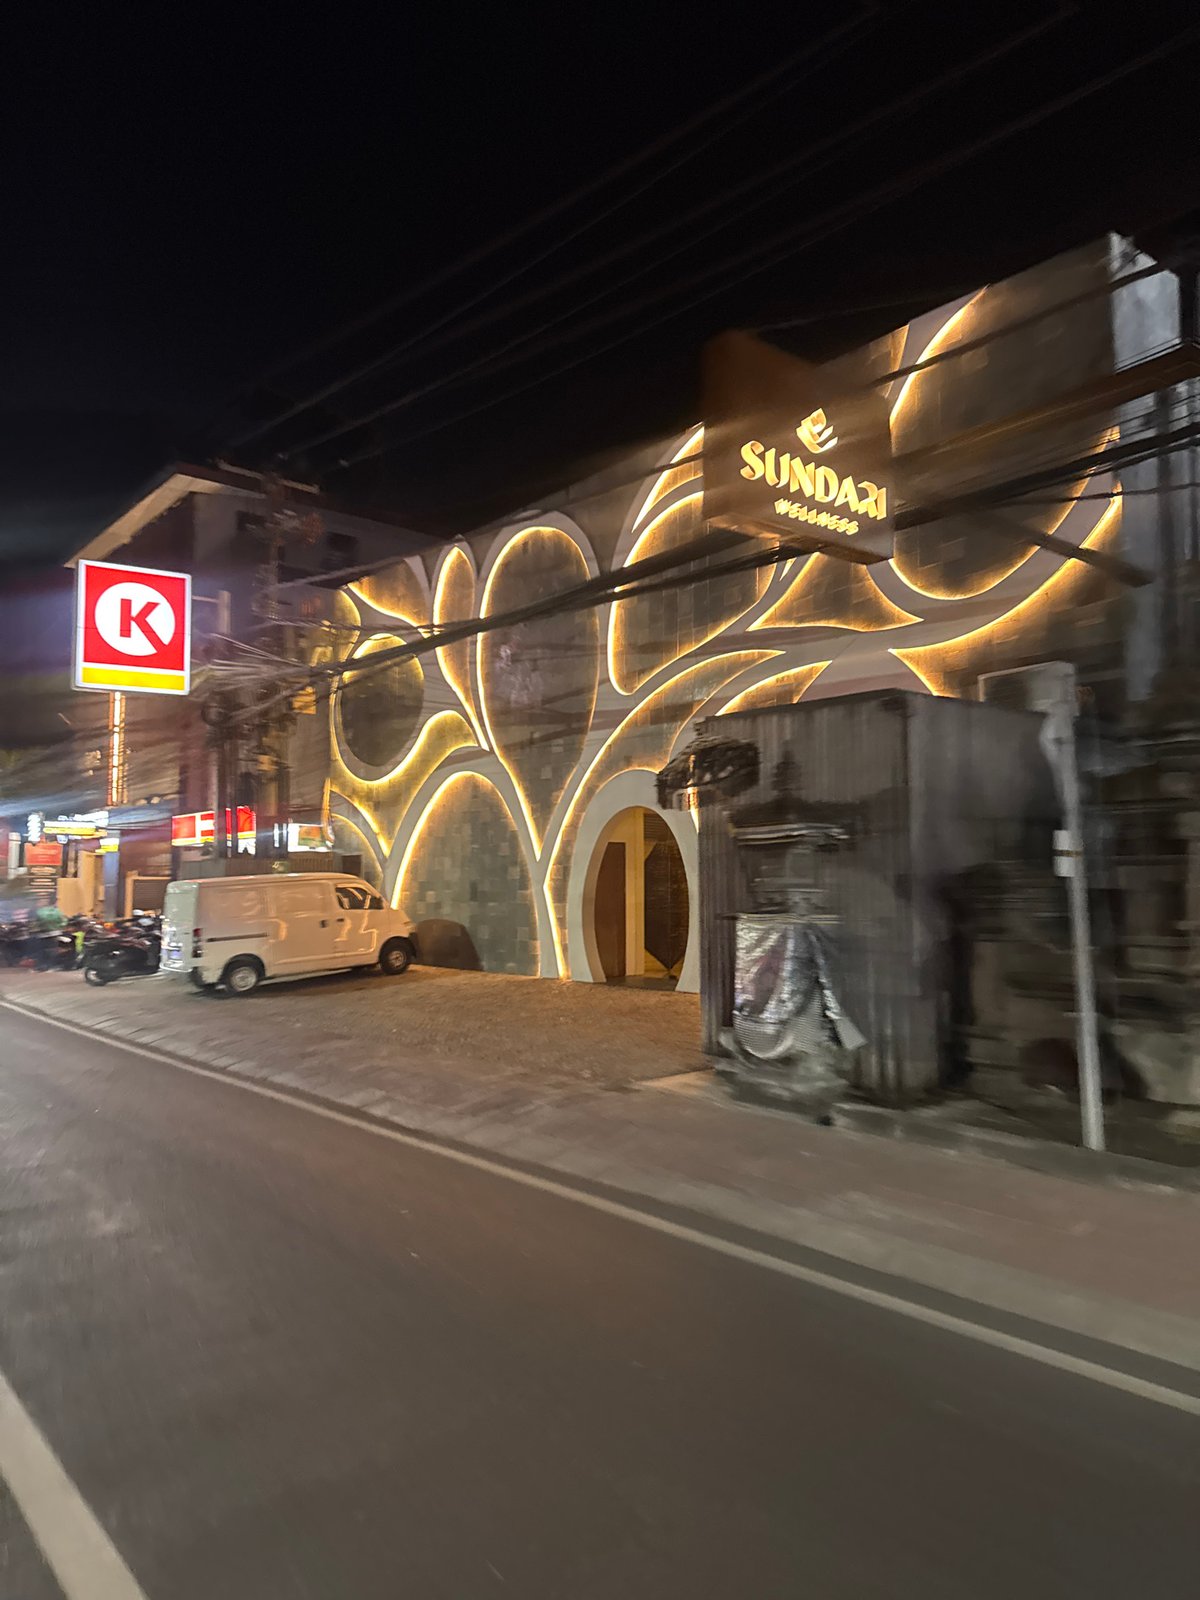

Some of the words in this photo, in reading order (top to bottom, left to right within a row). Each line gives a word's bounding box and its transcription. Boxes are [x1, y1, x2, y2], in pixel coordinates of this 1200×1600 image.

[740, 440, 887, 521] SUNDARI
[774, 498, 859, 536] WELLNESS
[119, 598, 169, 654] K
